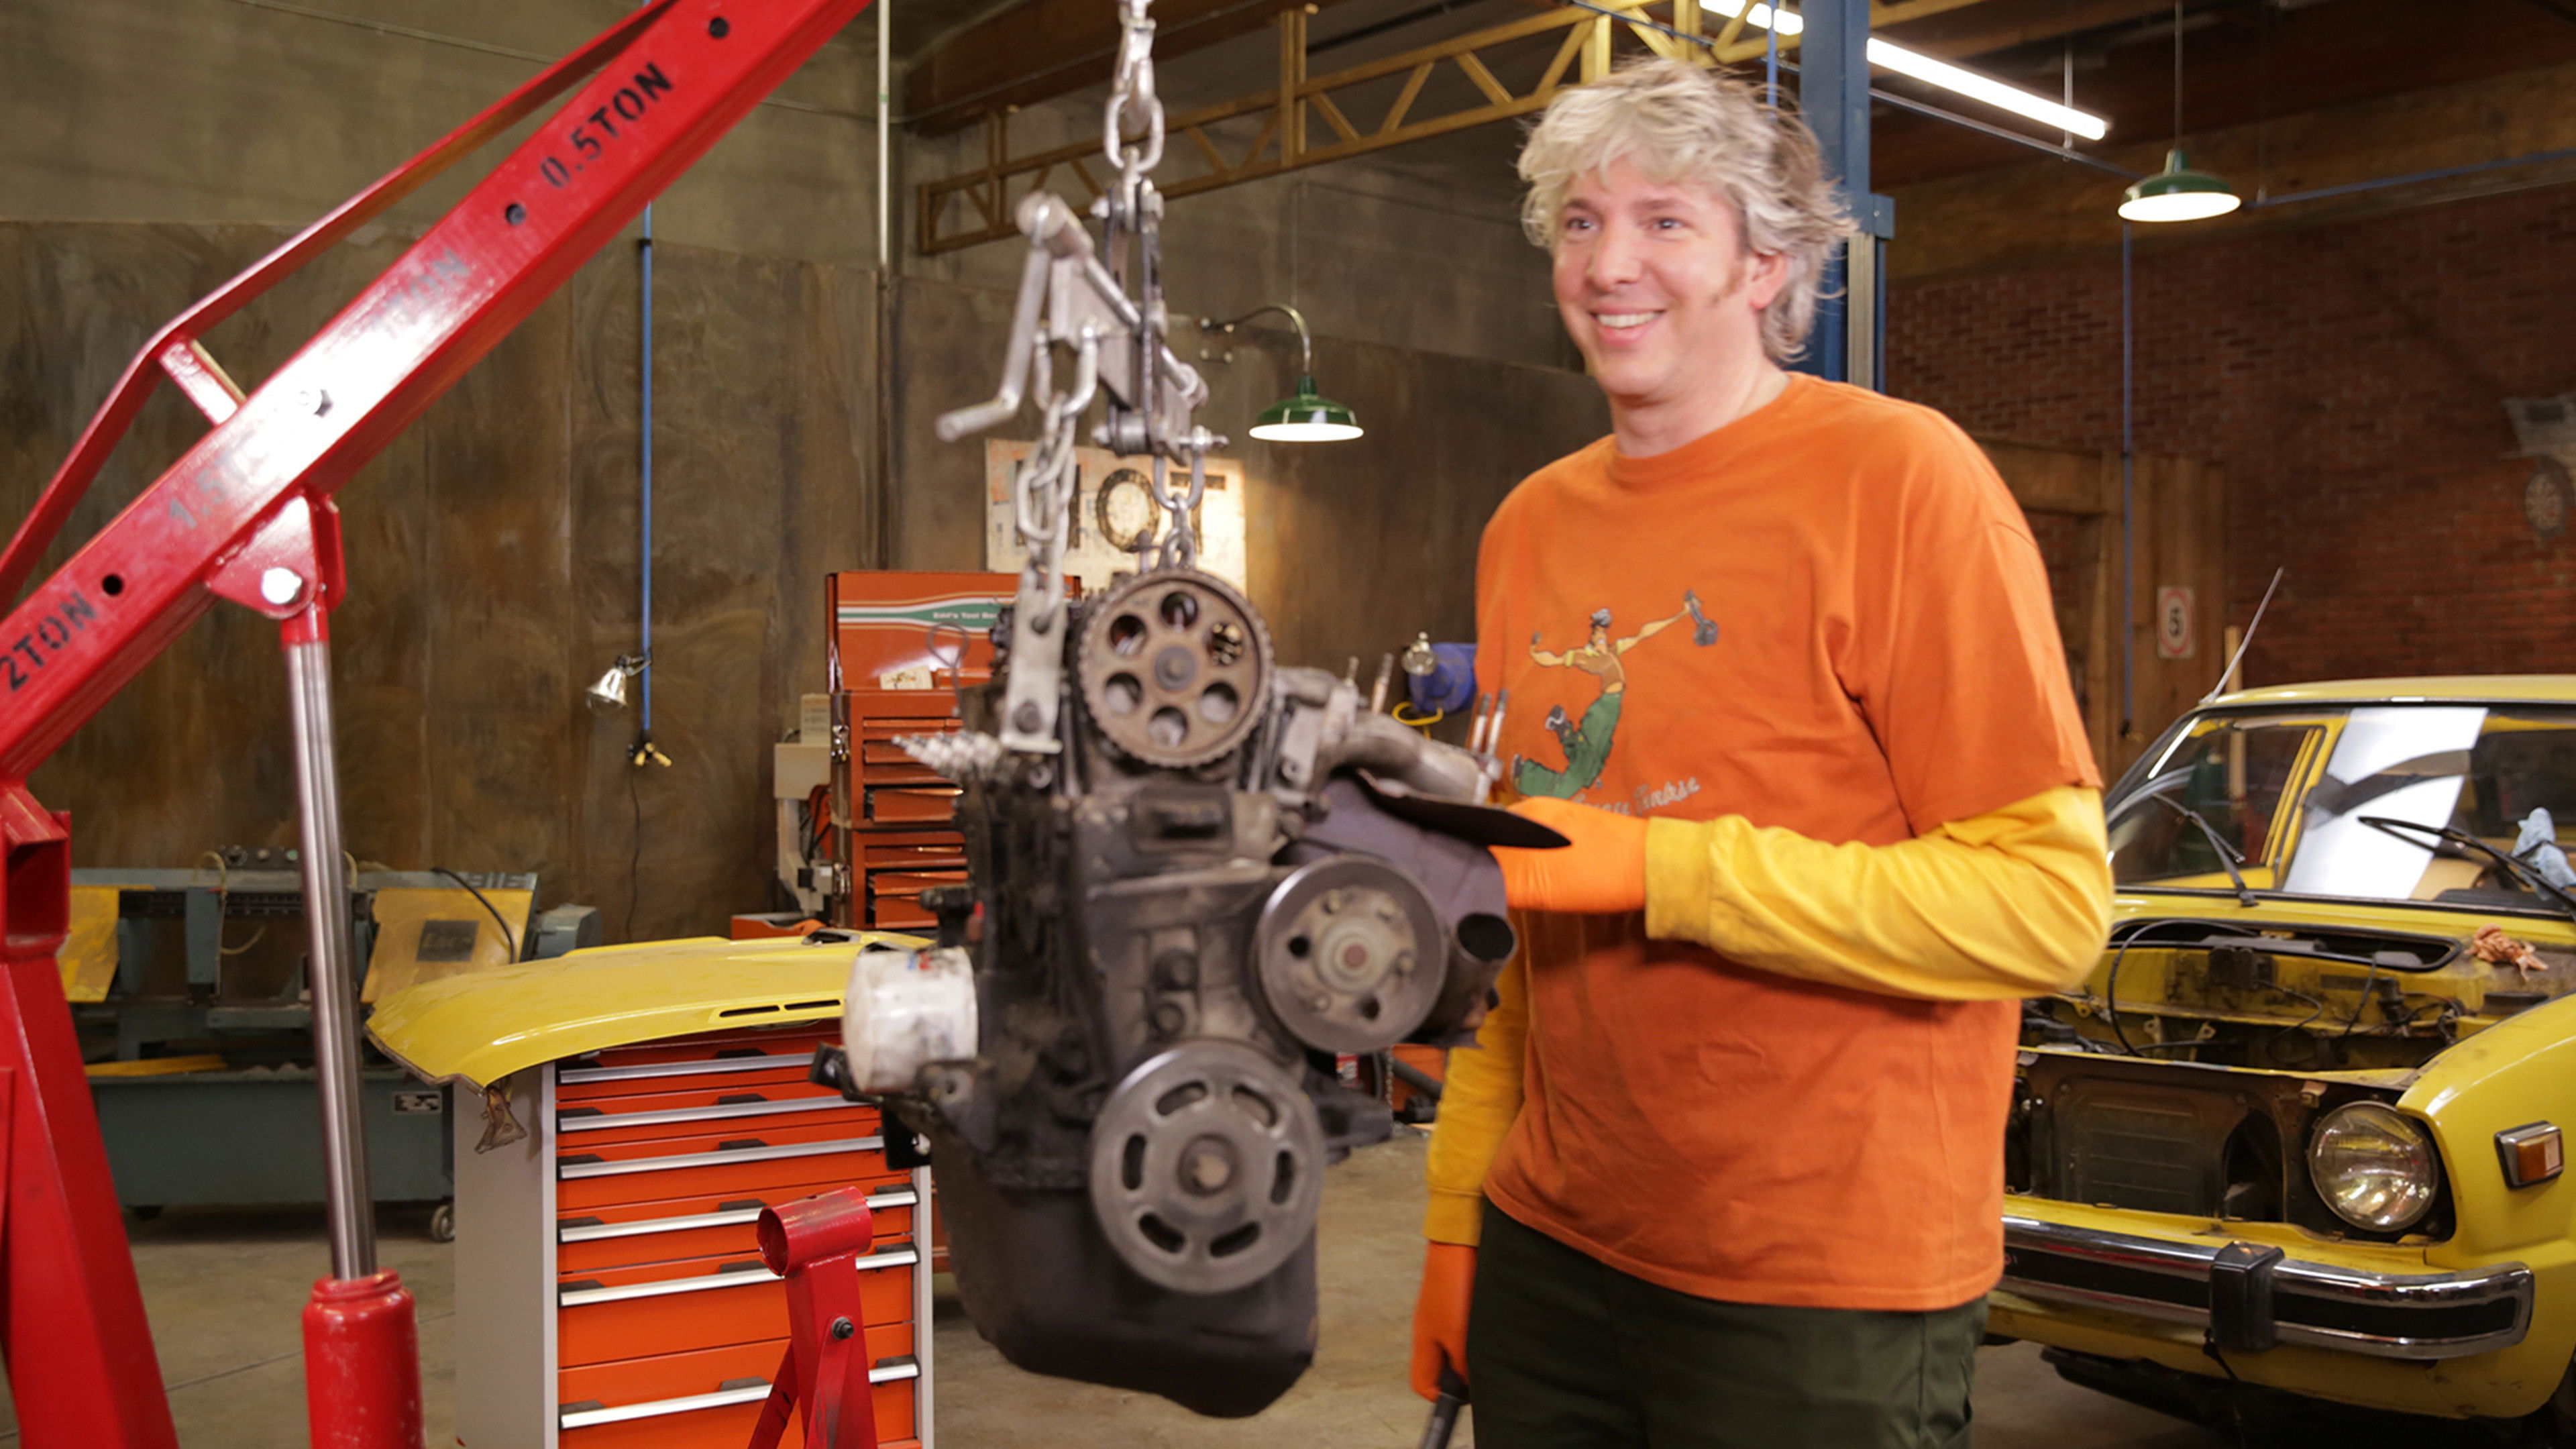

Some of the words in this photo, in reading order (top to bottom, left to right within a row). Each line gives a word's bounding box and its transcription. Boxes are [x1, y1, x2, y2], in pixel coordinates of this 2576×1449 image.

[540, 62, 673, 189] 0.5TON
[0, 591, 97, 691] 2TON
[960, 611, 980, 619] Tool
[2167, 606, 2185, 638] 5
